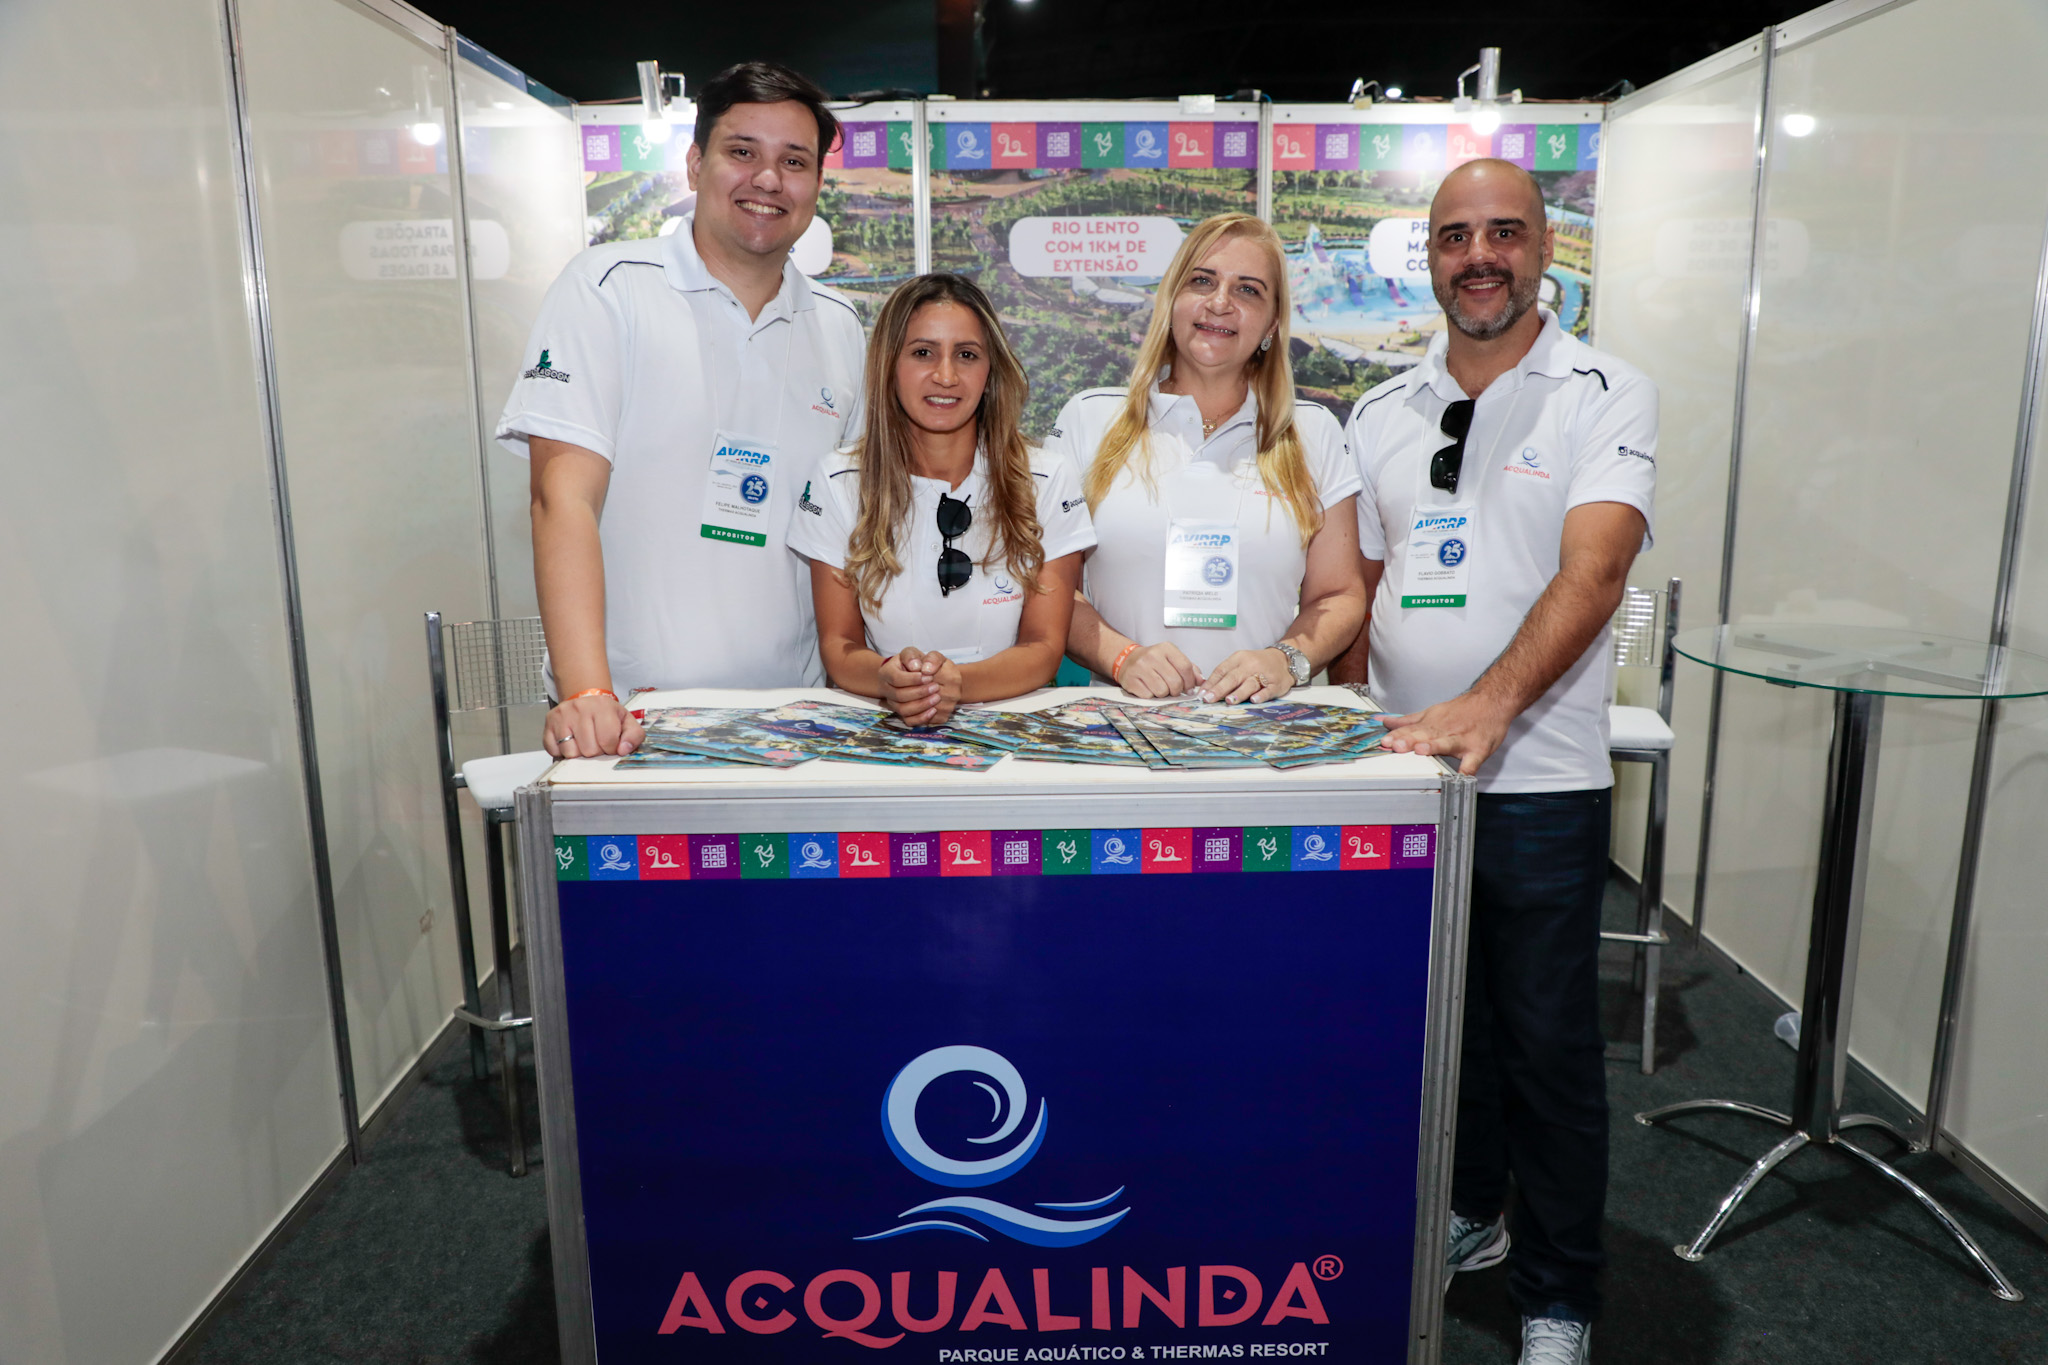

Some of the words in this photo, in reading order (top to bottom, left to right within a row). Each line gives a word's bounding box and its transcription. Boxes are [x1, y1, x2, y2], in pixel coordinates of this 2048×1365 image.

[1052, 221, 1081, 234] RIO
[1087, 221, 1140, 234] LENTO
[1045, 240, 1083, 253] COM
[1089, 240, 1121, 253] 1KM
[1126, 240, 1147, 253] DE
[1053, 255, 1139, 272] EXTENSÃO
[1503, 465, 1551, 479] ACQUALINDA
[744, 480, 764, 497] 25
[711, 529, 755, 541] EXPOSITOR
[1443, 543, 1462, 560] 25
[1208, 561, 1227, 578] 25
[657, 1262, 1331, 1349] ACQUALINDA
[938, 1348, 1020, 1362] PARQUE
[1024, 1344, 1127, 1362] AQUÁTICO
[1131, 1346, 1146, 1360] &
[1150, 1344, 1244, 1359] THERMAS
[1250, 1342, 1330, 1357] RESORT
